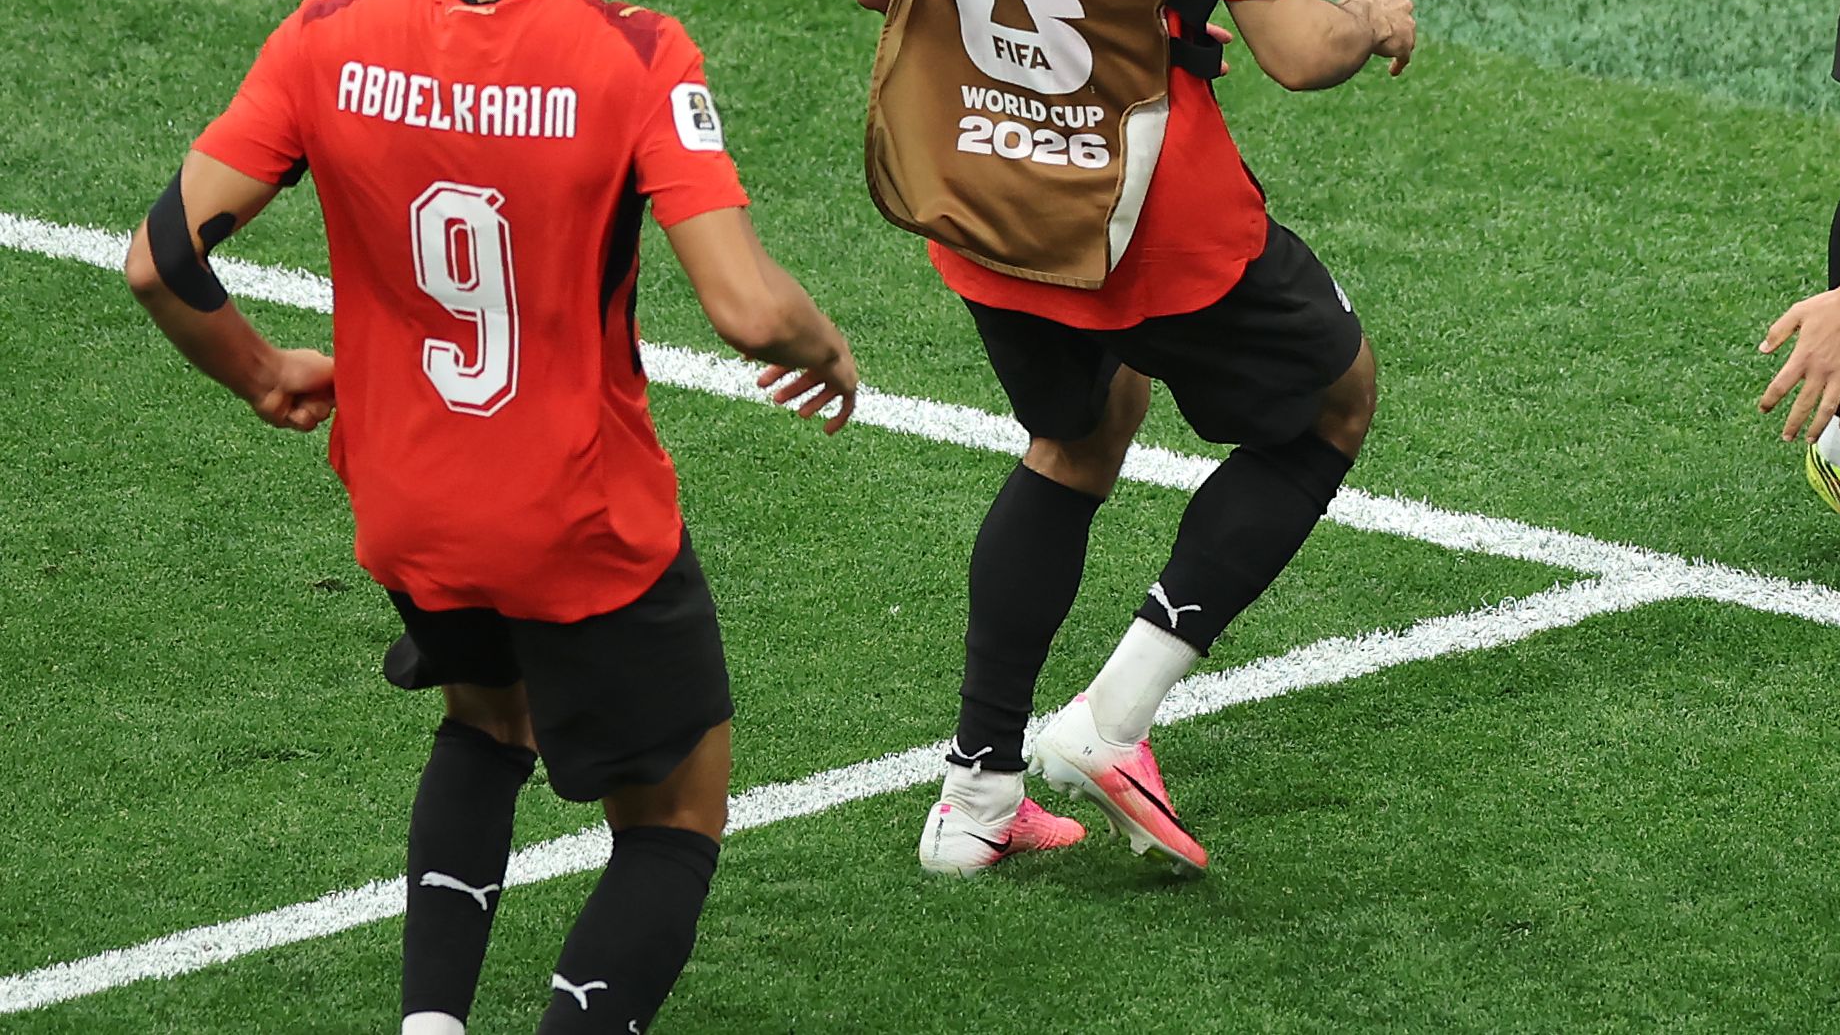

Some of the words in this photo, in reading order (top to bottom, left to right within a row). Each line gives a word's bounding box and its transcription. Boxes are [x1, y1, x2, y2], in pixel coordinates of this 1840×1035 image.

[992, 35, 1053, 71] FIFA
[337, 60, 578, 139] ABDELKARIM
[960, 85, 1047, 123] WORLD
[1050, 105, 1105, 129] CUP
[956, 115, 1111, 169] 2026
[409, 180, 519, 417] 9
